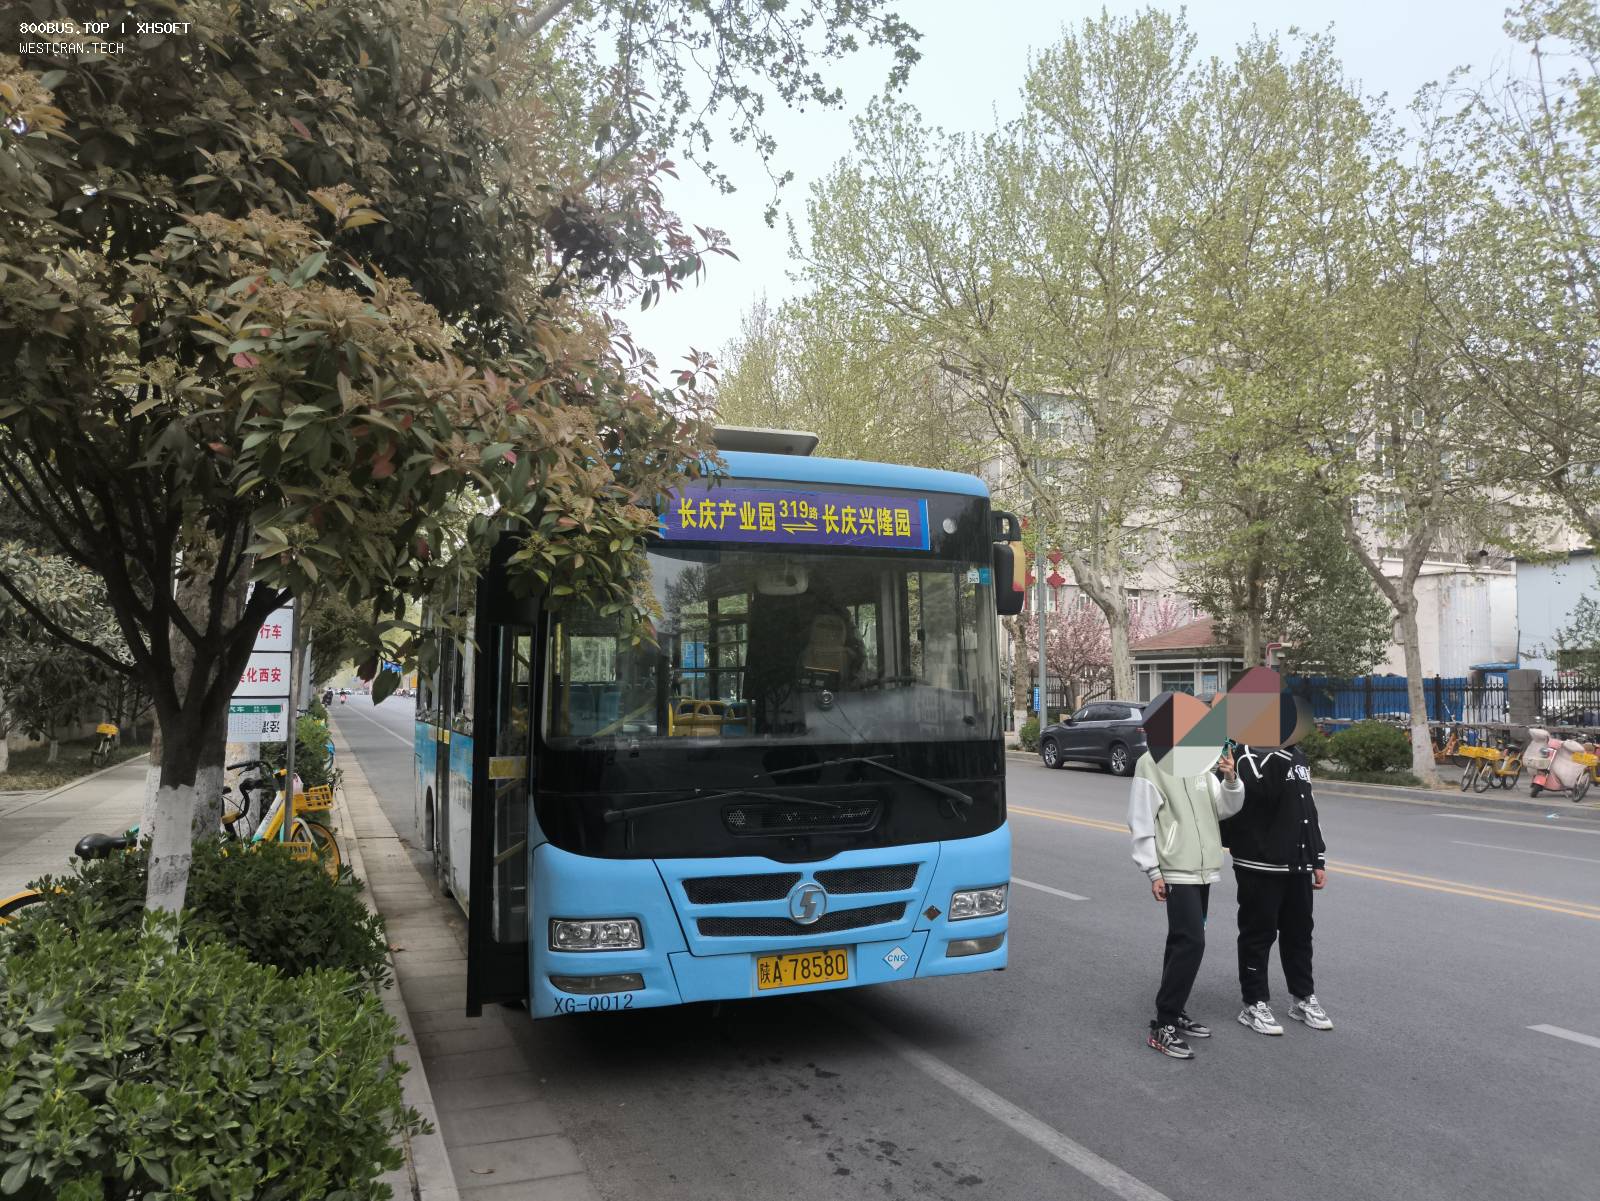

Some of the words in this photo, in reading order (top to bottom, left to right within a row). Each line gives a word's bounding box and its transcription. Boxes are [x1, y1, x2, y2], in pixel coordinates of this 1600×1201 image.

[678, 497, 776, 532] 长庆产业园
[779, 499, 818, 519] 319路
[822, 504, 911, 537] 长庆兴隆园
[887, 954, 906, 963] CNG
